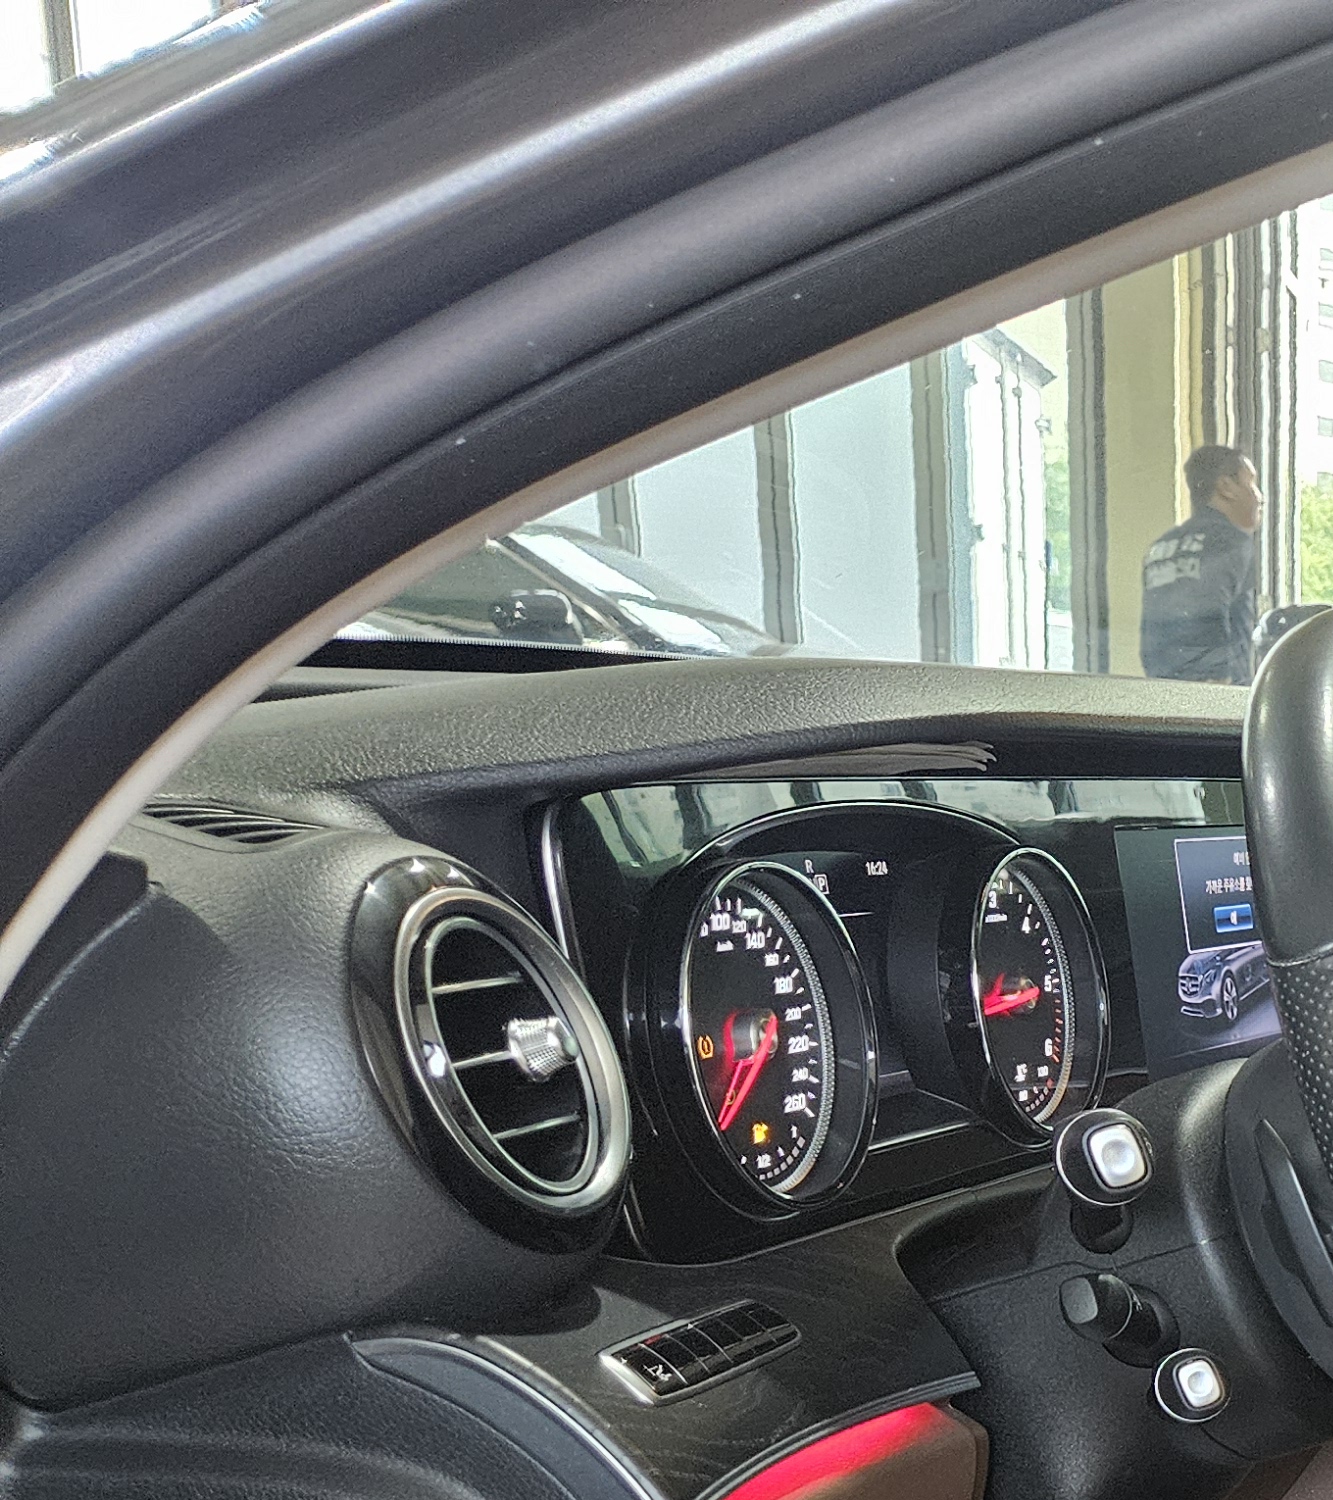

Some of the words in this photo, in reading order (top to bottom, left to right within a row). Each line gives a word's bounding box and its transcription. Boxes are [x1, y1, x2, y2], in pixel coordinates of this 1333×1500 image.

[805, 859, 814, 873] R
[818, 877, 825, 891] P
[988, 890, 997, 908] 3
[710, 912, 730, 931] 100
[732, 920, 747, 933] 120
[1021, 916, 1031, 934] 4
[745, 931, 765, 950] 140
[765, 952, 779, 966] 160
[774, 976, 793, 994] 180
[1044, 974, 1052, 992] 5
[785, 1007, 801, 1021] 200
[788, 1035, 809, 1054] 220
[1045, 1038, 1052, 1056] 6
[792, 1067, 808, 1082] 240
[784, 1093, 806, 1113] 260
